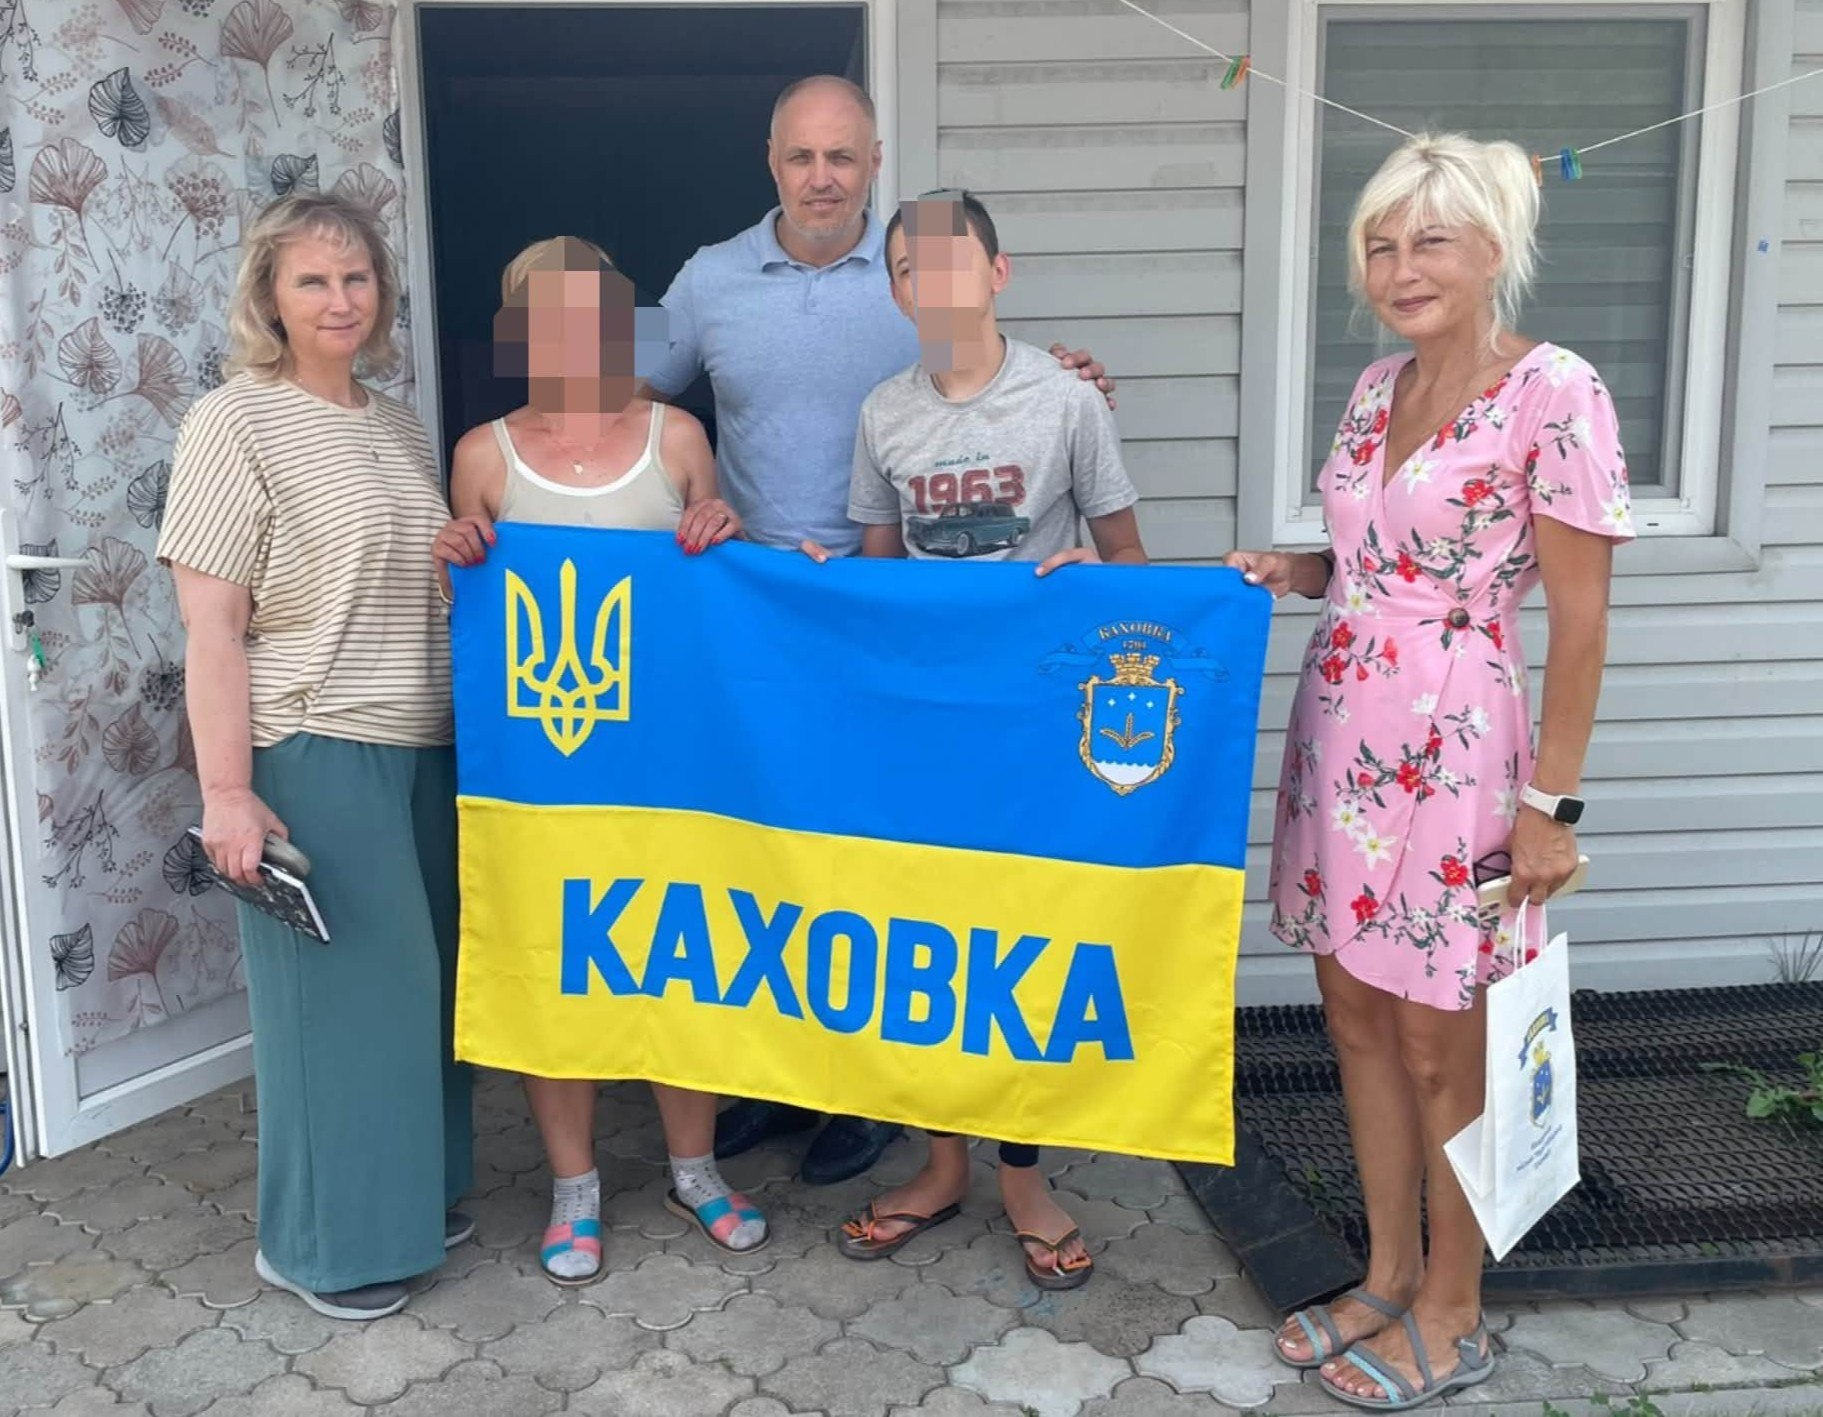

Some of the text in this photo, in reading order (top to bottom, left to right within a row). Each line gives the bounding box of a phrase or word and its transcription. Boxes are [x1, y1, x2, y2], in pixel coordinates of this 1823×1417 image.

[908, 464, 1027, 516] 1963
[1098, 622, 1172, 643] КАХОВКА
[561, 878, 1134, 1063] КАХОВКА
